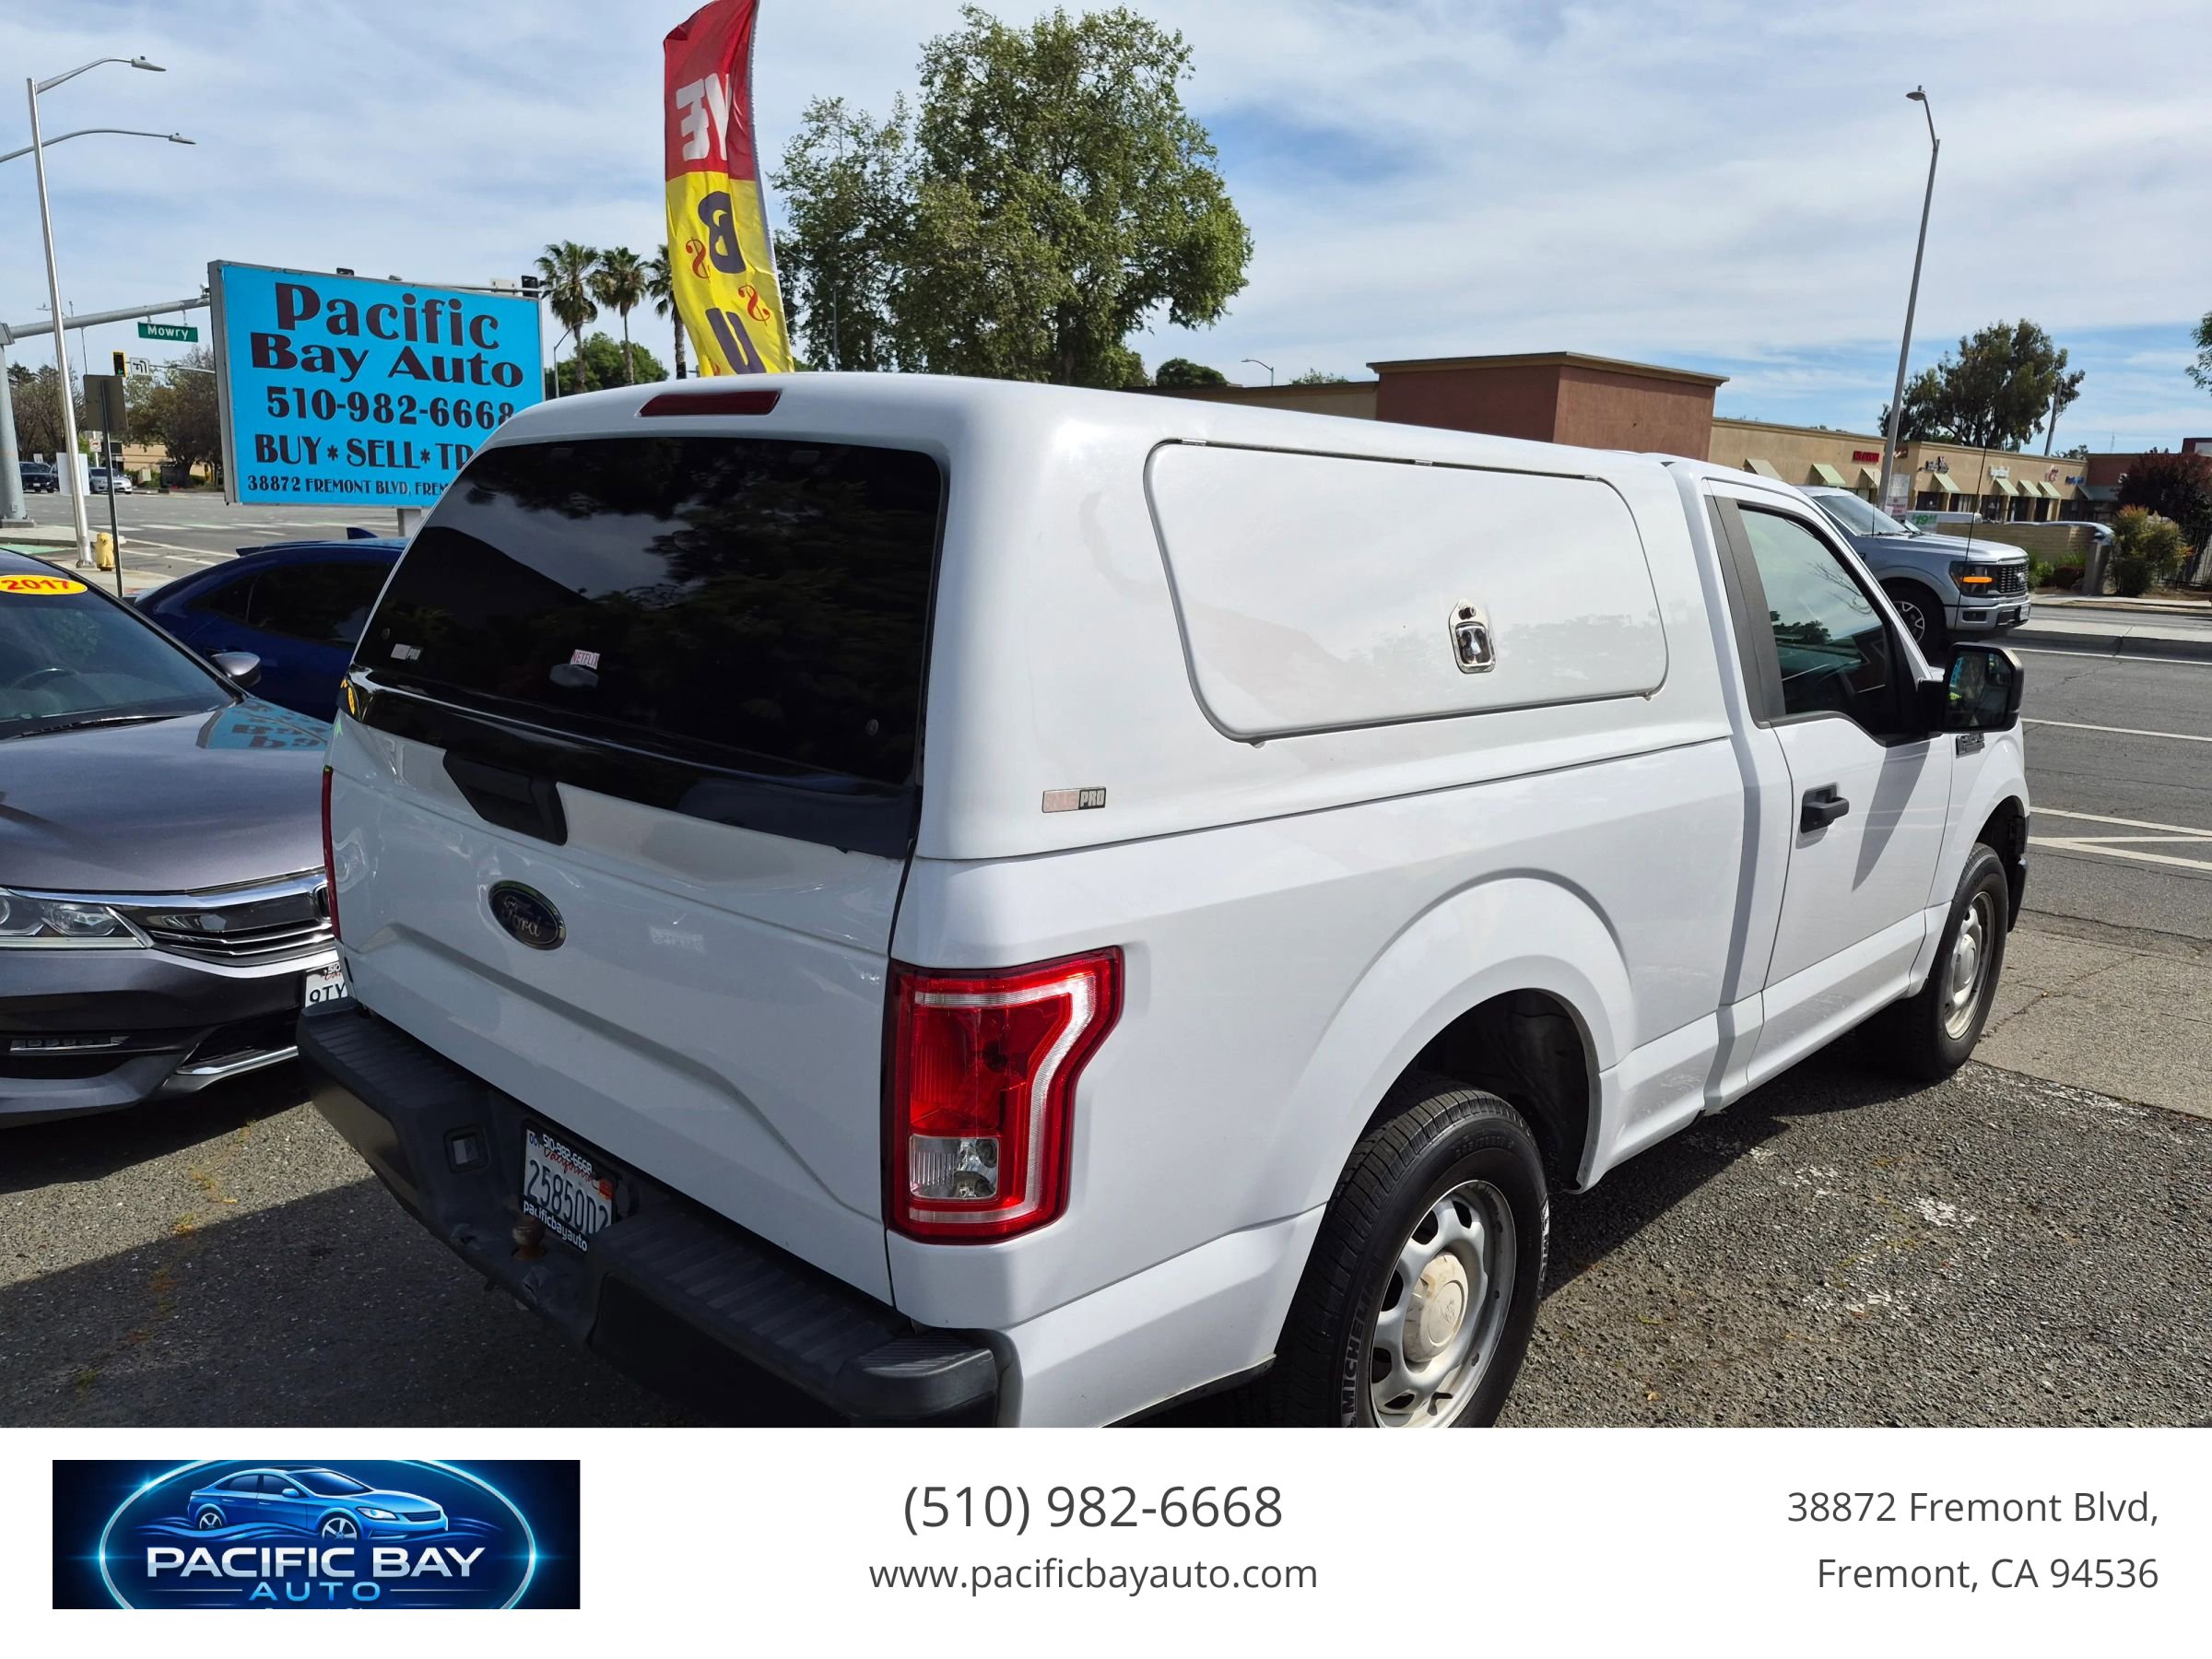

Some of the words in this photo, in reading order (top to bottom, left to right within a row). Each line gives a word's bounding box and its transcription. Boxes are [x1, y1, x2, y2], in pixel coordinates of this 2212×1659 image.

[147, 324, 189, 341] Mowry
[275, 282, 500, 350] Pacific
[250, 332, 370, 382] Bay
[387, 345, 524, 388] Auto
[266, 385, 514, 430] 510-982-6668
[254, 433, 322, 465] BUY
[346, 438, 421, 469] SELL
[247, 475, 301, 492] 38872
[305, 477, 371, 495] FREMONT
[0, 578, 70, 591] 2017
[1079, 790, 1105, 807] PRO
[523, 1199, 588, 1253] pacificbayauto
